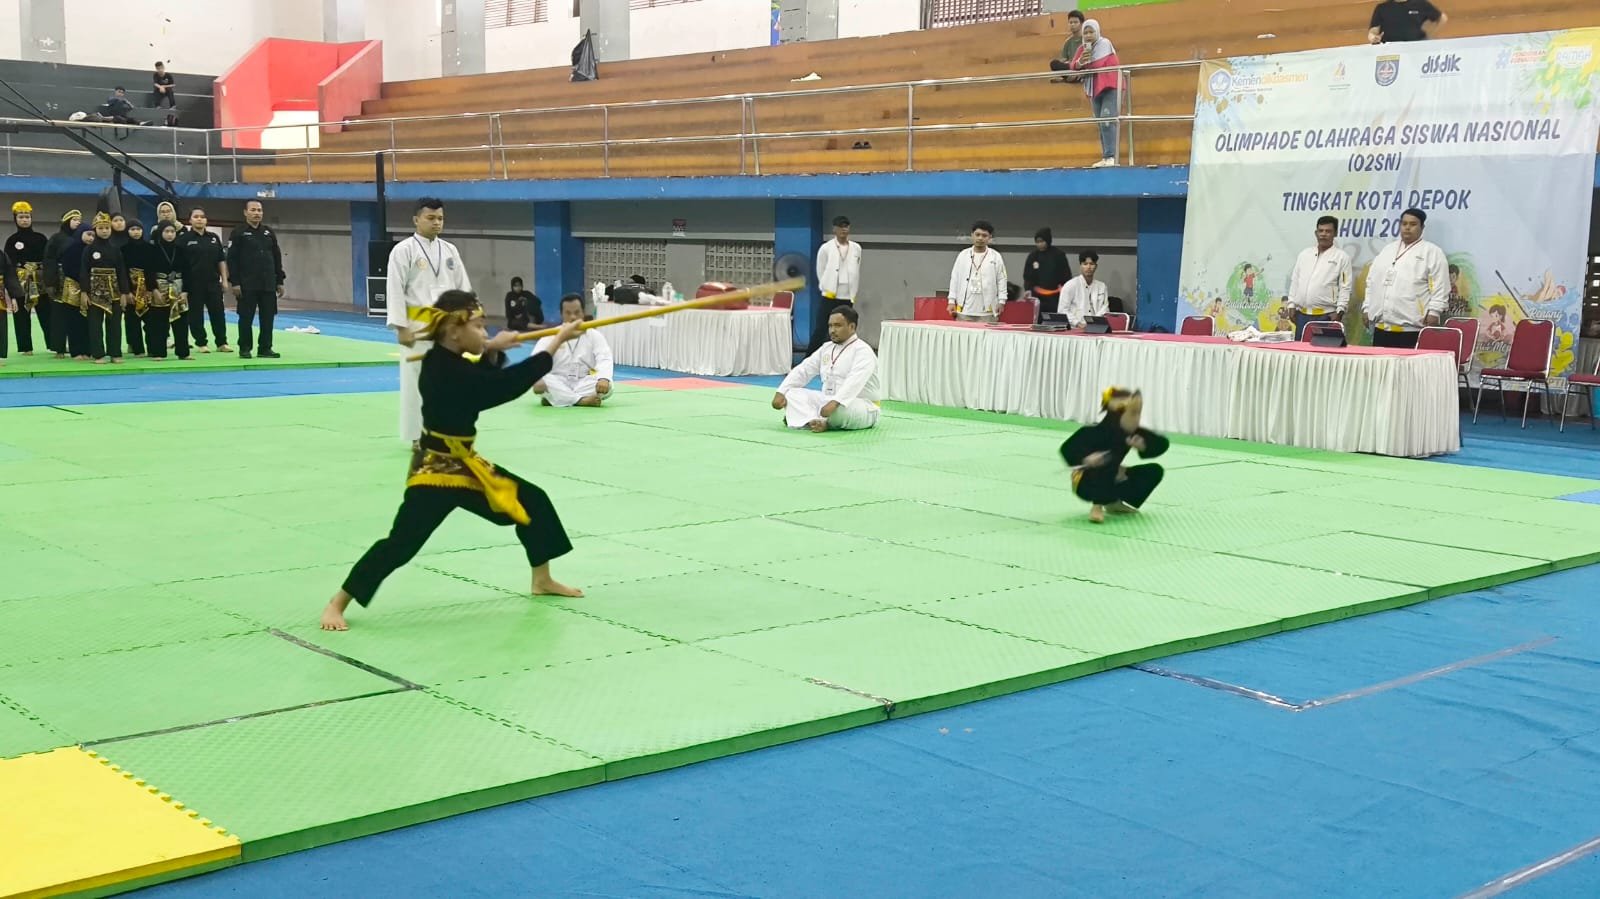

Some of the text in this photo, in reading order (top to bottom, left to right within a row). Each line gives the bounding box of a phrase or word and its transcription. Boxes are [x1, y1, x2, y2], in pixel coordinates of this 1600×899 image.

[1215, 118, 1561, 152] OLIMPIADE OLAHRAGA SISWA NASIONAL
[1283, 189, 1471, 211] TINGKAT KOTA DEPOK
